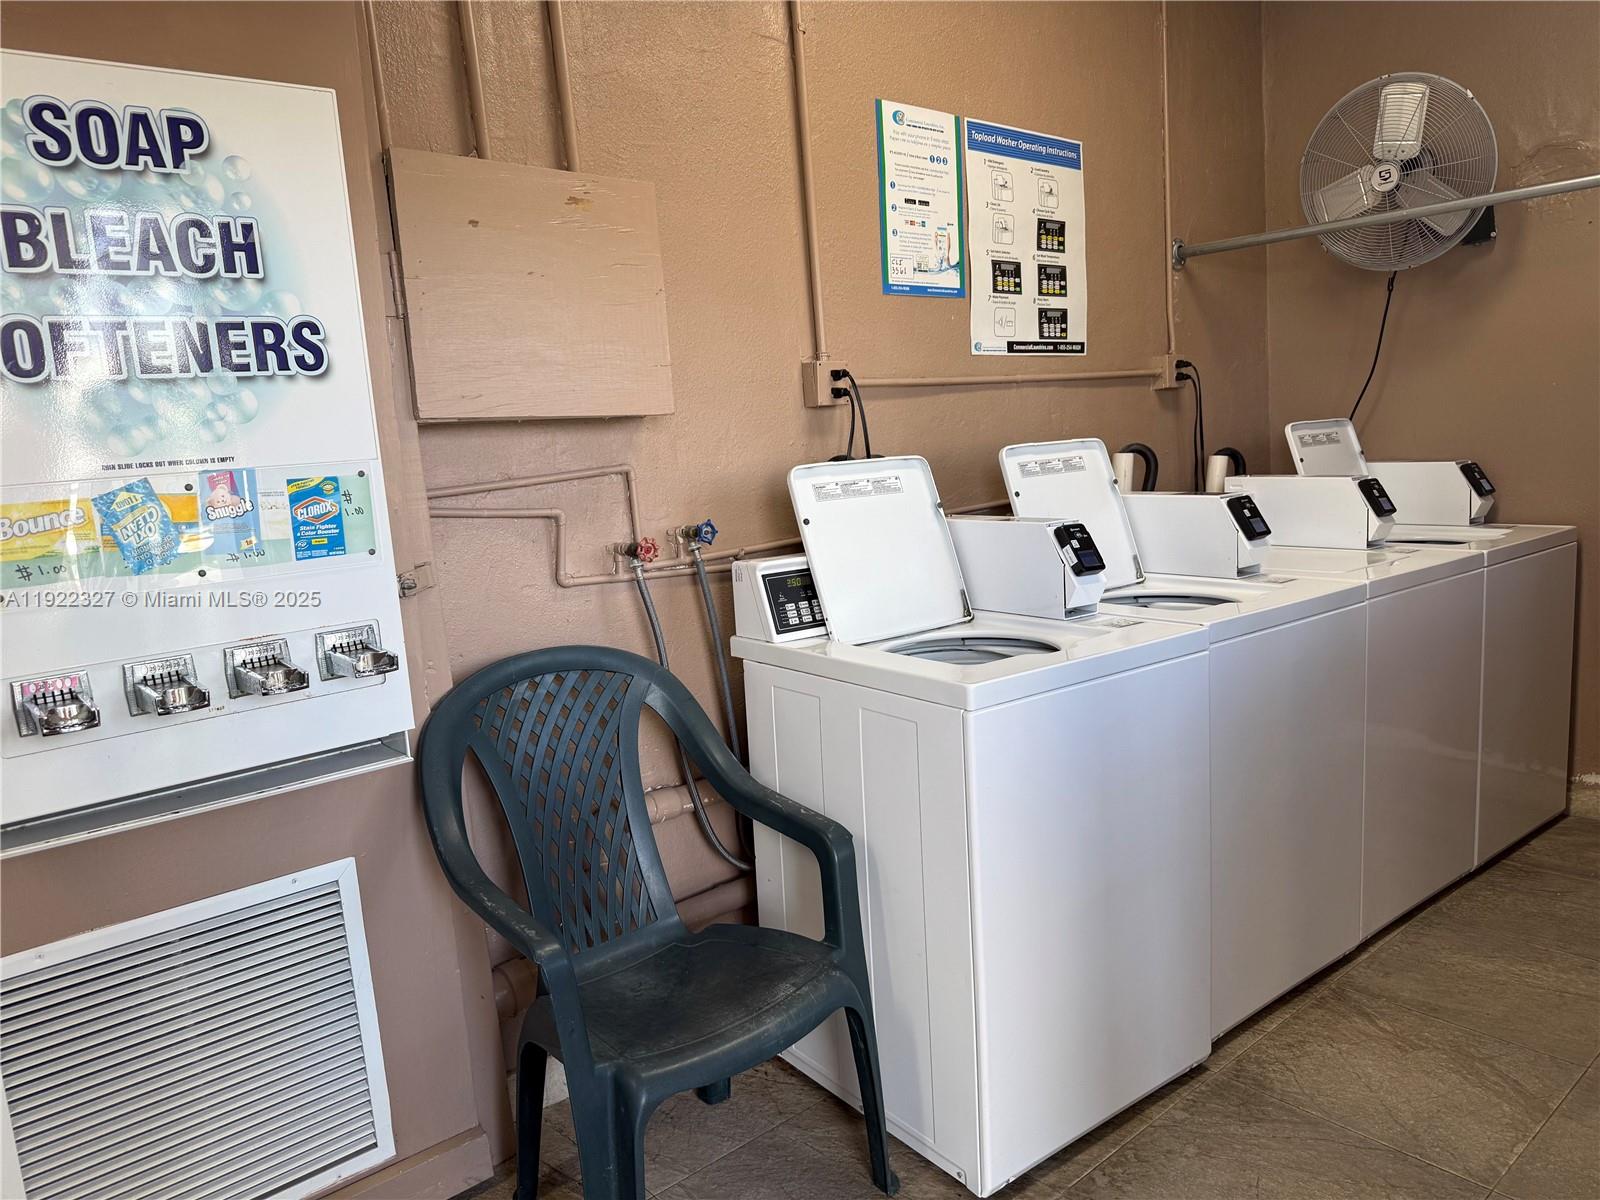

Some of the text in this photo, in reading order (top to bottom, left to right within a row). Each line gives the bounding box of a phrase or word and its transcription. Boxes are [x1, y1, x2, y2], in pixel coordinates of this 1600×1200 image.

[25, 98, 208, 173] SOAP
[972, 130, 1077, 159] Topload Washer Operating Instructions
[1, 208, 262, 277] BLEACH
[0, 506, 86, 542] Bounce
[120, 506, 159, 542] CLEAN
[206, 498, 254, 521] Snuggle
[134, 521, 156, 544] OXI
